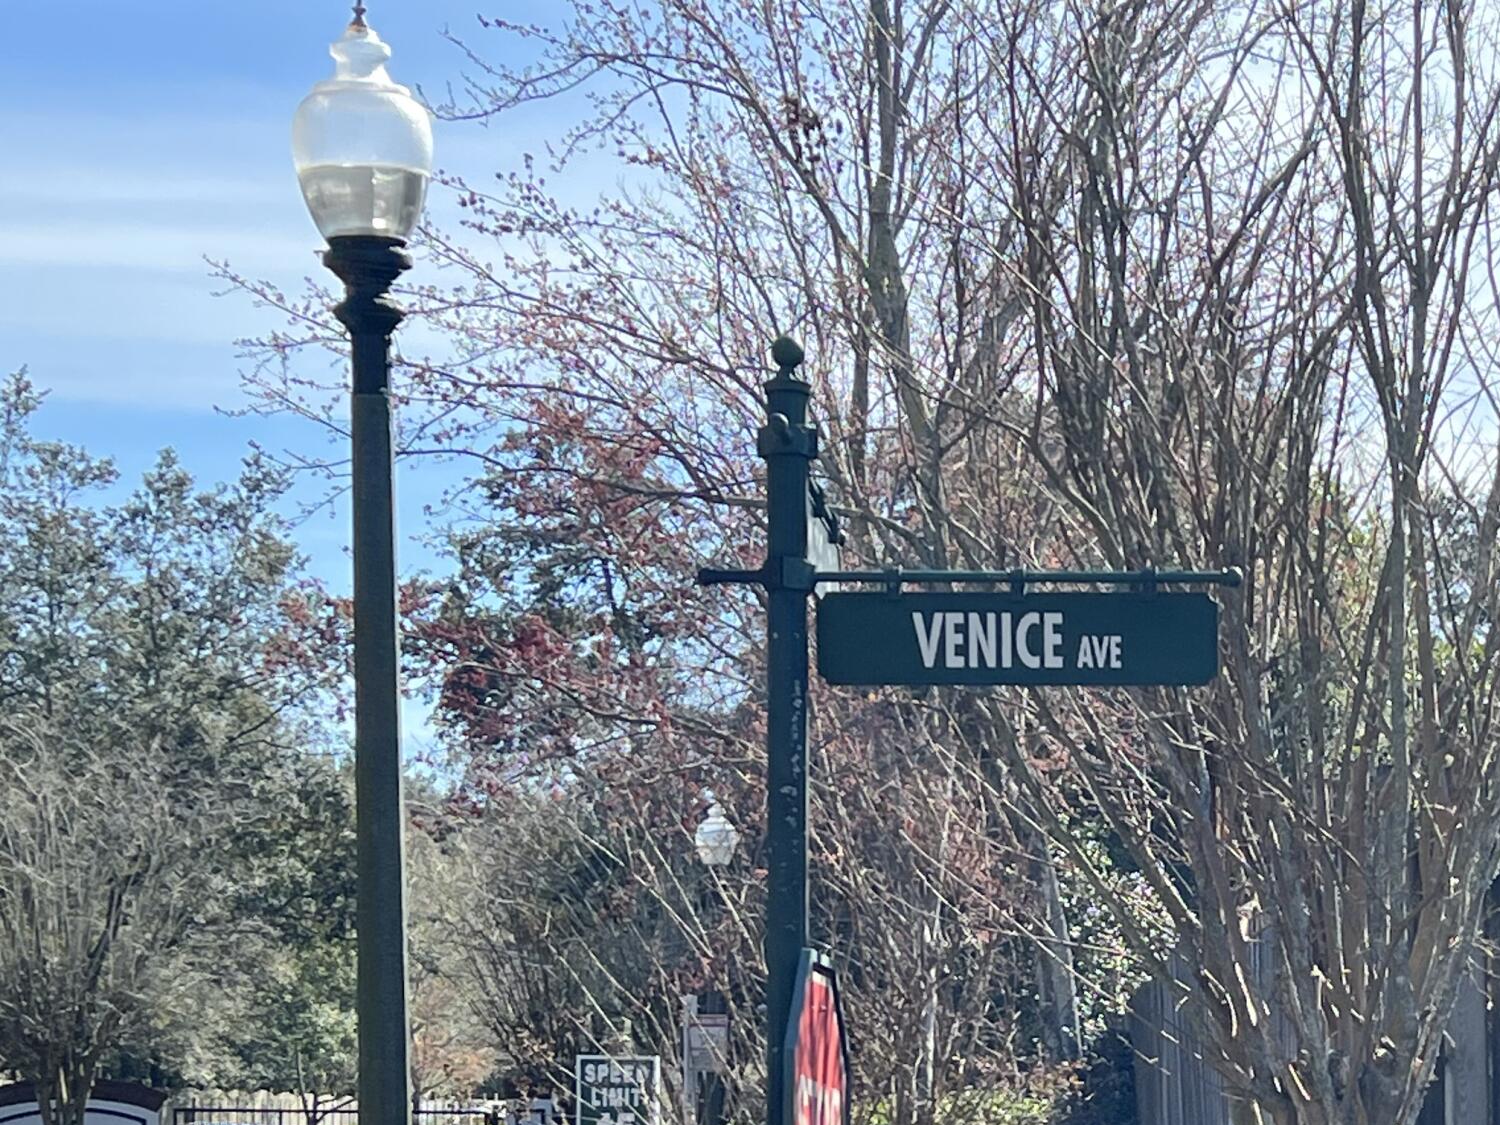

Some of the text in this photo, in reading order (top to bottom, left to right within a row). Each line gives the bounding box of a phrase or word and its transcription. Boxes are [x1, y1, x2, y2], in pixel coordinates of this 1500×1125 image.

[911, 611, 1122, 669] VENICE AVE
[584, 1063, 650, 1083] SPEED
[591, 1087, 640, 1107] LIMIT
